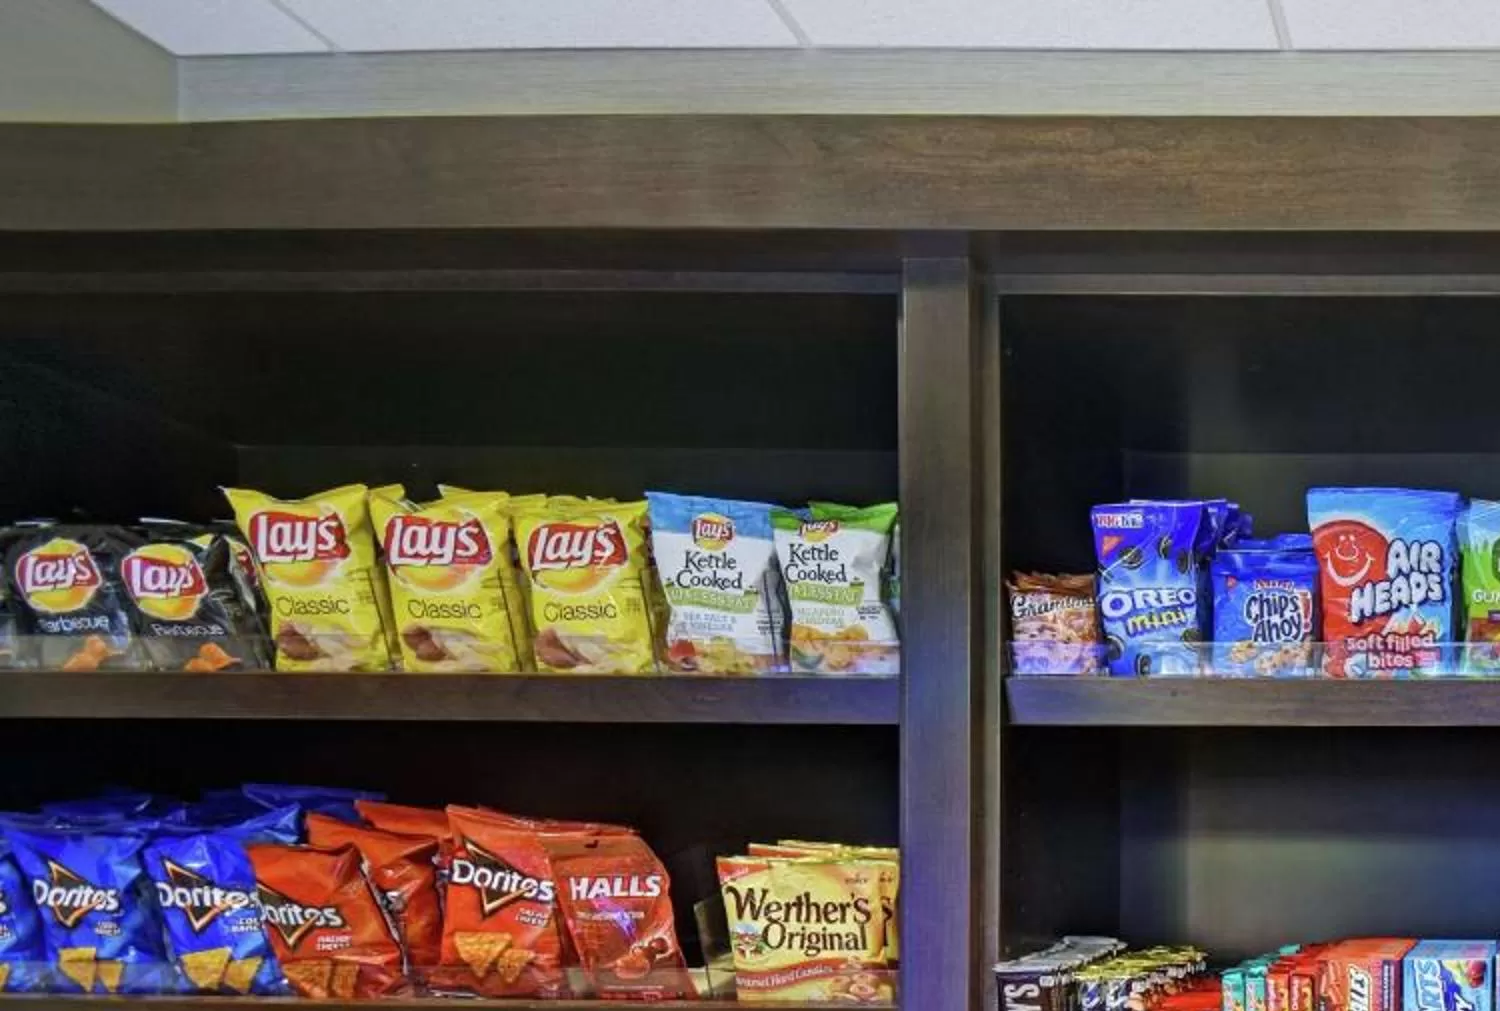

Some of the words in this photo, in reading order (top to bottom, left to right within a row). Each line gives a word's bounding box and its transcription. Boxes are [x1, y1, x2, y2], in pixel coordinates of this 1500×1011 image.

[257, 514, 339, 562] Lay's
[390, 517, 480, 566] Lay's
[532, 524, 617, 570] Lay's
[685, 551, 738, 571] Kettle
[788, 543, 839, 563] Kettle
[1387, 538, 1442, 577] AIR
[21, 550, 92, 594] Lay's
[676, 570, 744, 591] Cooked
[784, 563, 848, 585] Cooked
[275, 596, 351, 617] Classic
[407, 599, 484, 620] Classic
[542, 601, 618, 622] Classic
[1101, 587, 1198, 618] OREO
[1246, 592, 1300, 622] Chips
[1350, 572, 1443, 622] HEADS
[1126, 608, 1188, 636] mini
[1346, 634, 1385, 652] Soft
[1385, 631, 1435, 653] filled
[1368, 652, 1415, 670] bites
[33, 878, 120, 911] Doritos
[451, 859, 555, 901] Doritos
[569, 875, 662, 901] HALLS
[156, 881, 260, 910] Doritos
[724, 885, 872, 922] Werther's
[763, 919, 868, 957] Original
